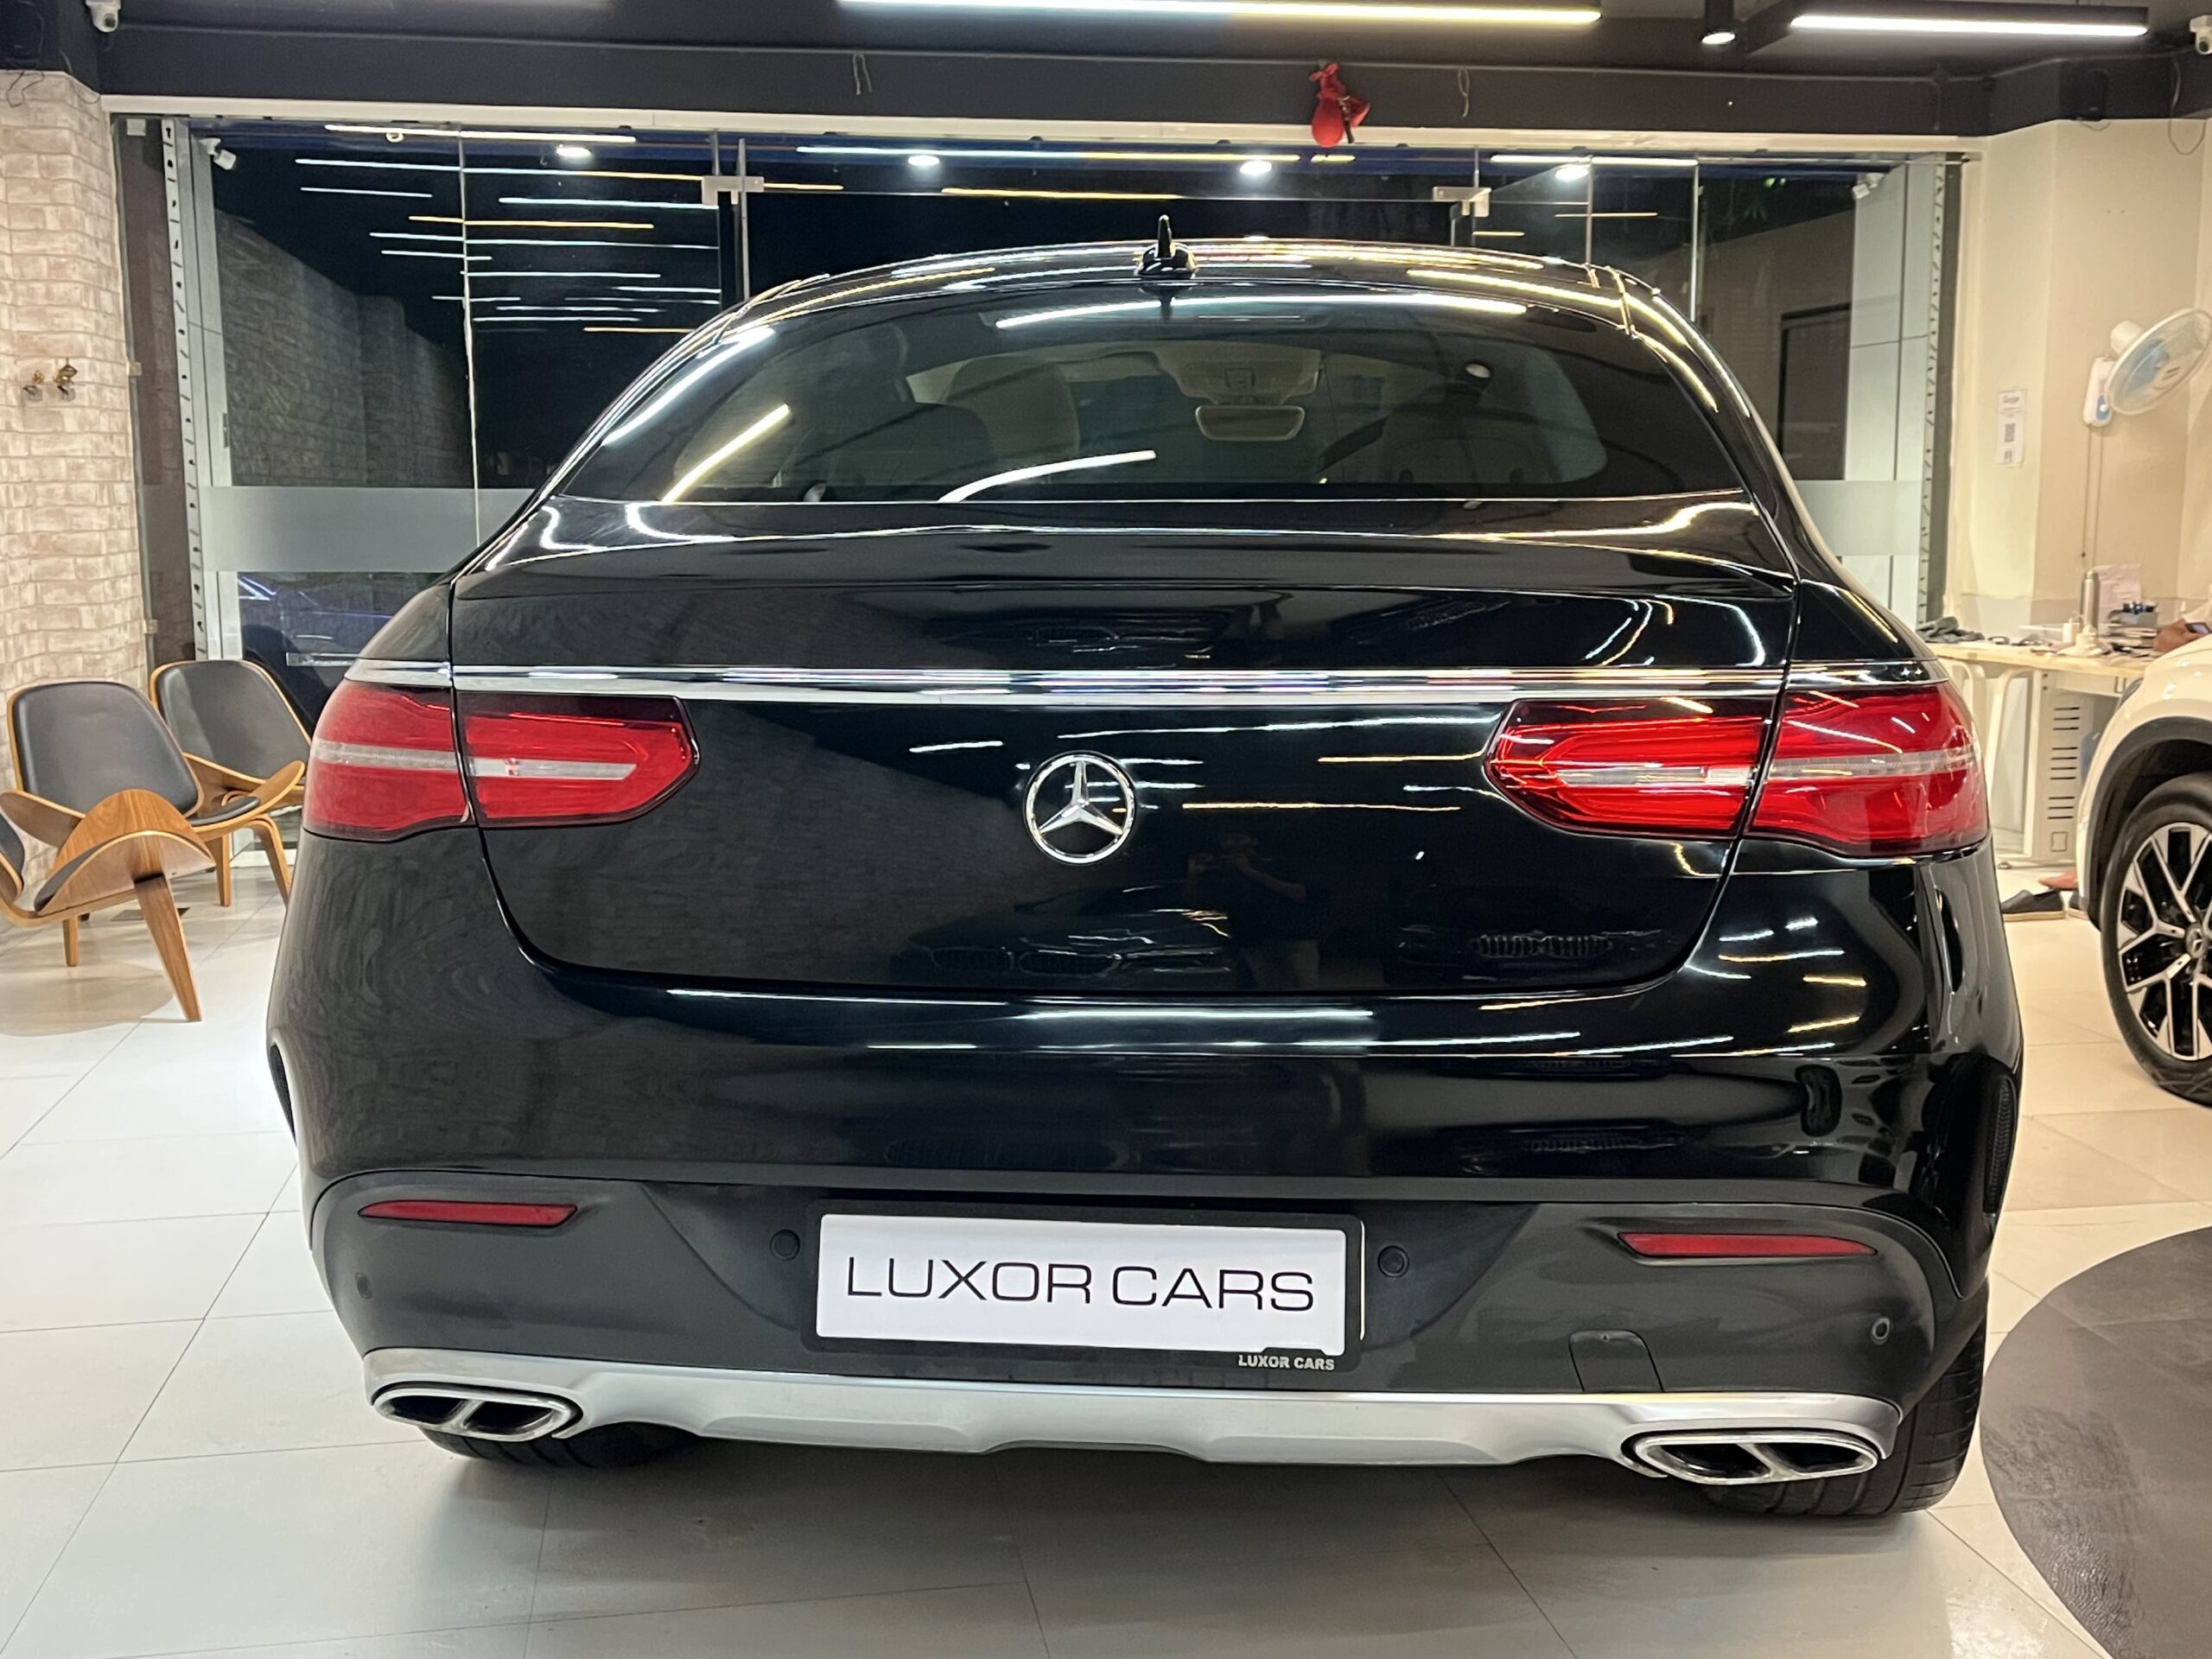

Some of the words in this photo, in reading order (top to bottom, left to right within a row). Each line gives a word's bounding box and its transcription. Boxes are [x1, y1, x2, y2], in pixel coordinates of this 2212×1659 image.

[847, 1256, 1092, 1304] LUXOR
[1112, 1266, 1313, 1312] CARS
[1238, 1354, 1290, 1369] LUXOR
[1294, 1357, 1336, 1371] CARS
